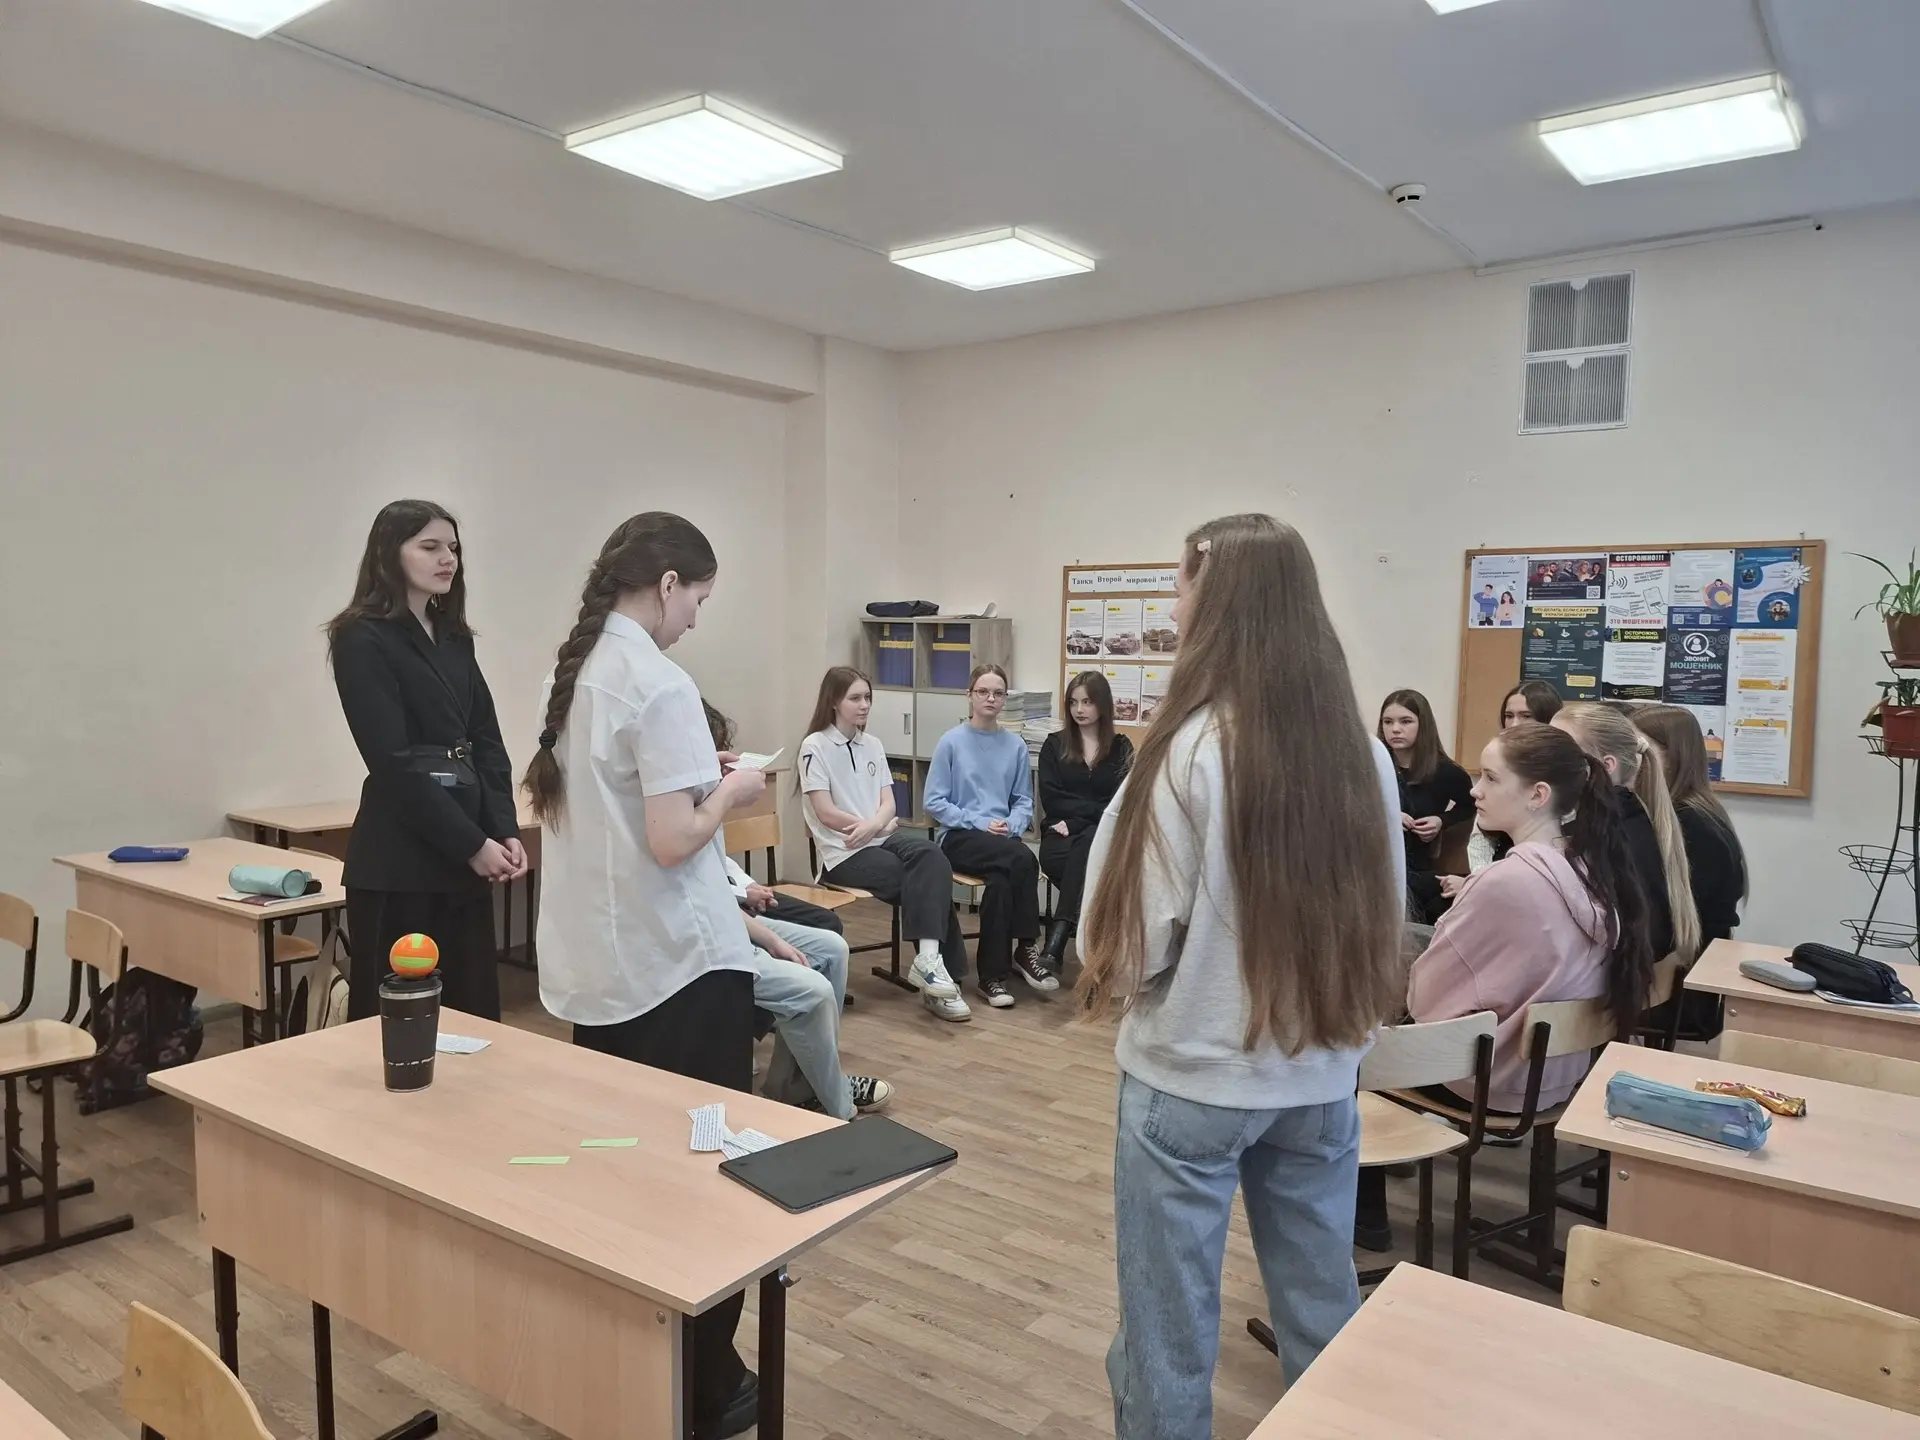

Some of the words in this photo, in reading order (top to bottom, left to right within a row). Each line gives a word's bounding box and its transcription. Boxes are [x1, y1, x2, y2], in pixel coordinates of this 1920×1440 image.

[1615, 554, 1664, 562] ОСТОРОЖНО!!!
[1072, 577, 1093, 585] Танки
[1097, 575, 1122, 584] Второй
[1126, 576, 1157, 585] мировой
[1670, 662, 1722, 670] МОШЕННИК
[802, 753, 813, 778] 7
